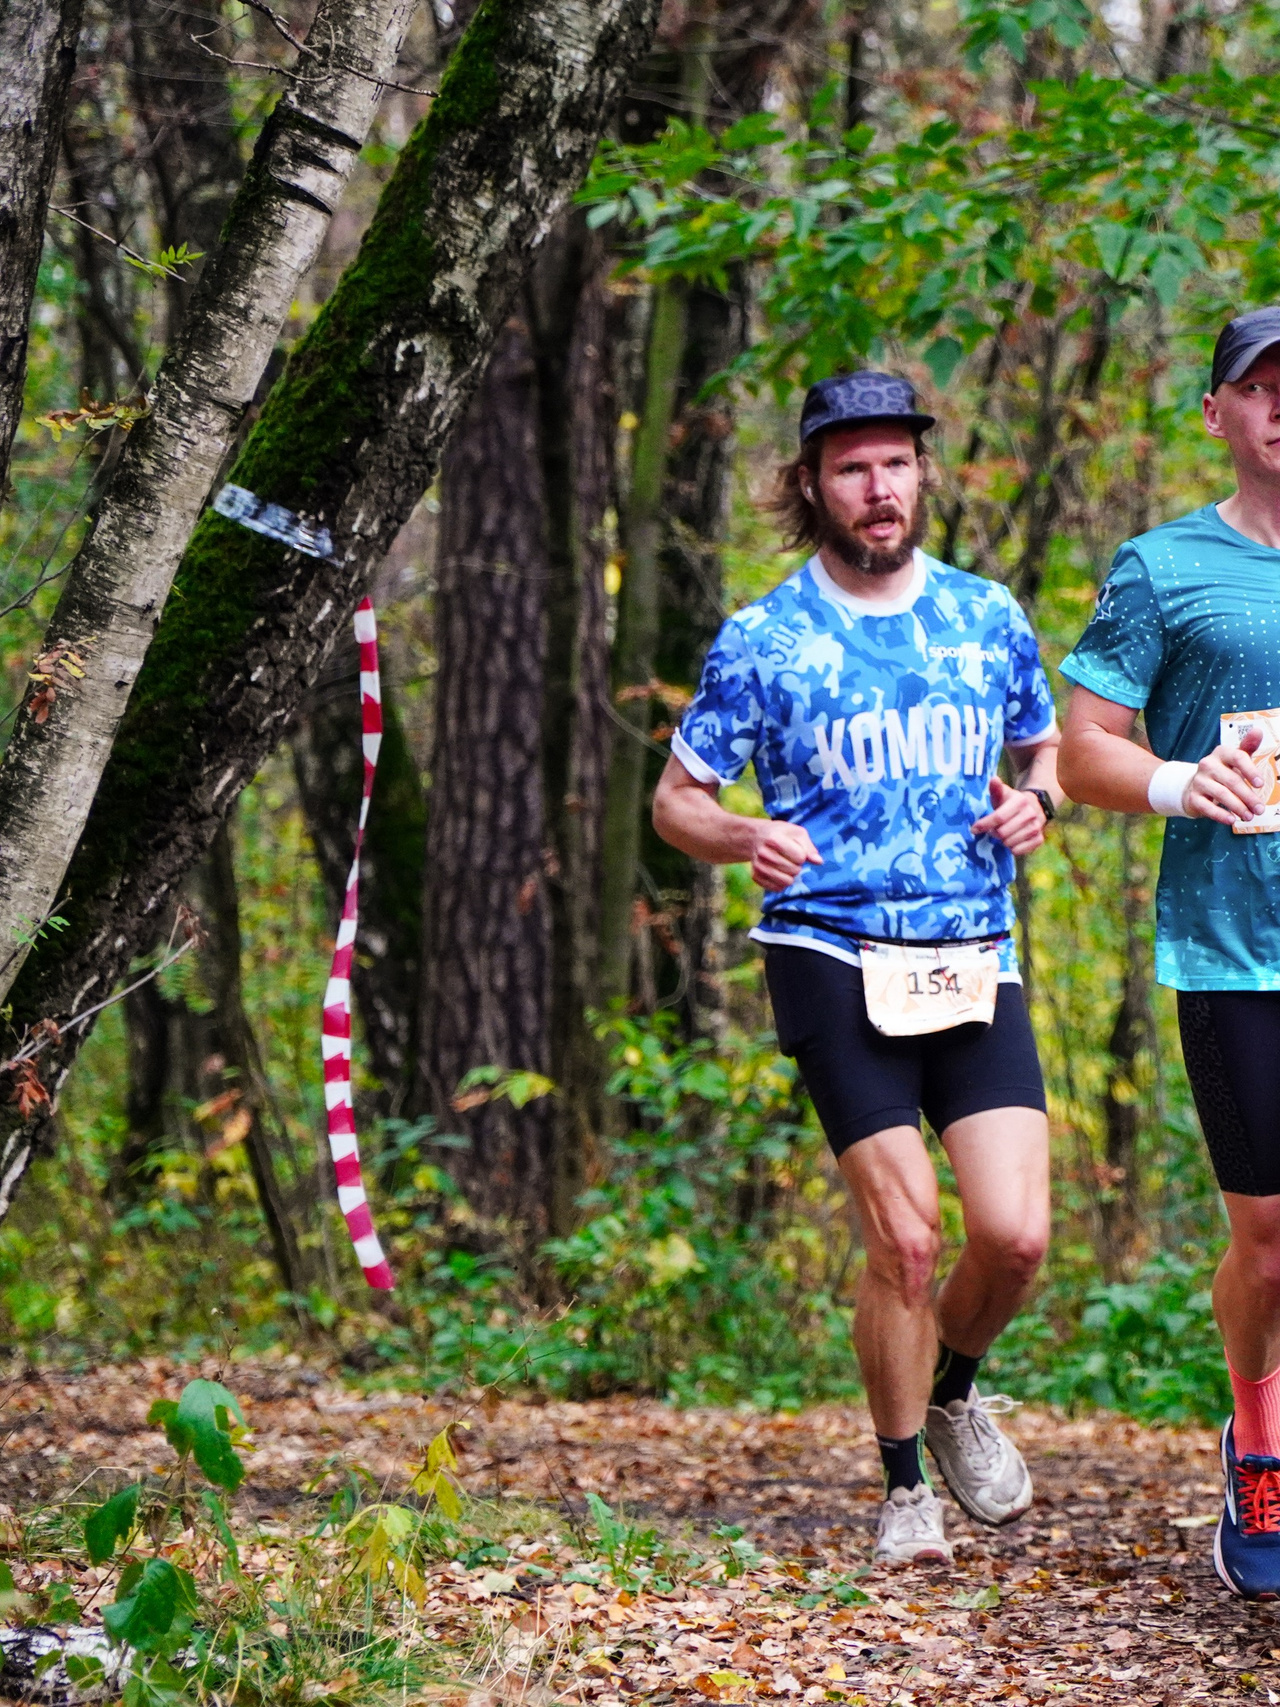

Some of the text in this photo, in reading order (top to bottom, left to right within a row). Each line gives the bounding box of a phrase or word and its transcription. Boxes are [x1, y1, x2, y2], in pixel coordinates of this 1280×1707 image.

[928, 645, 995, 662] sporru
[814, 703, 989, 790] КОМОН
[908, 971, 962, 994] 154
